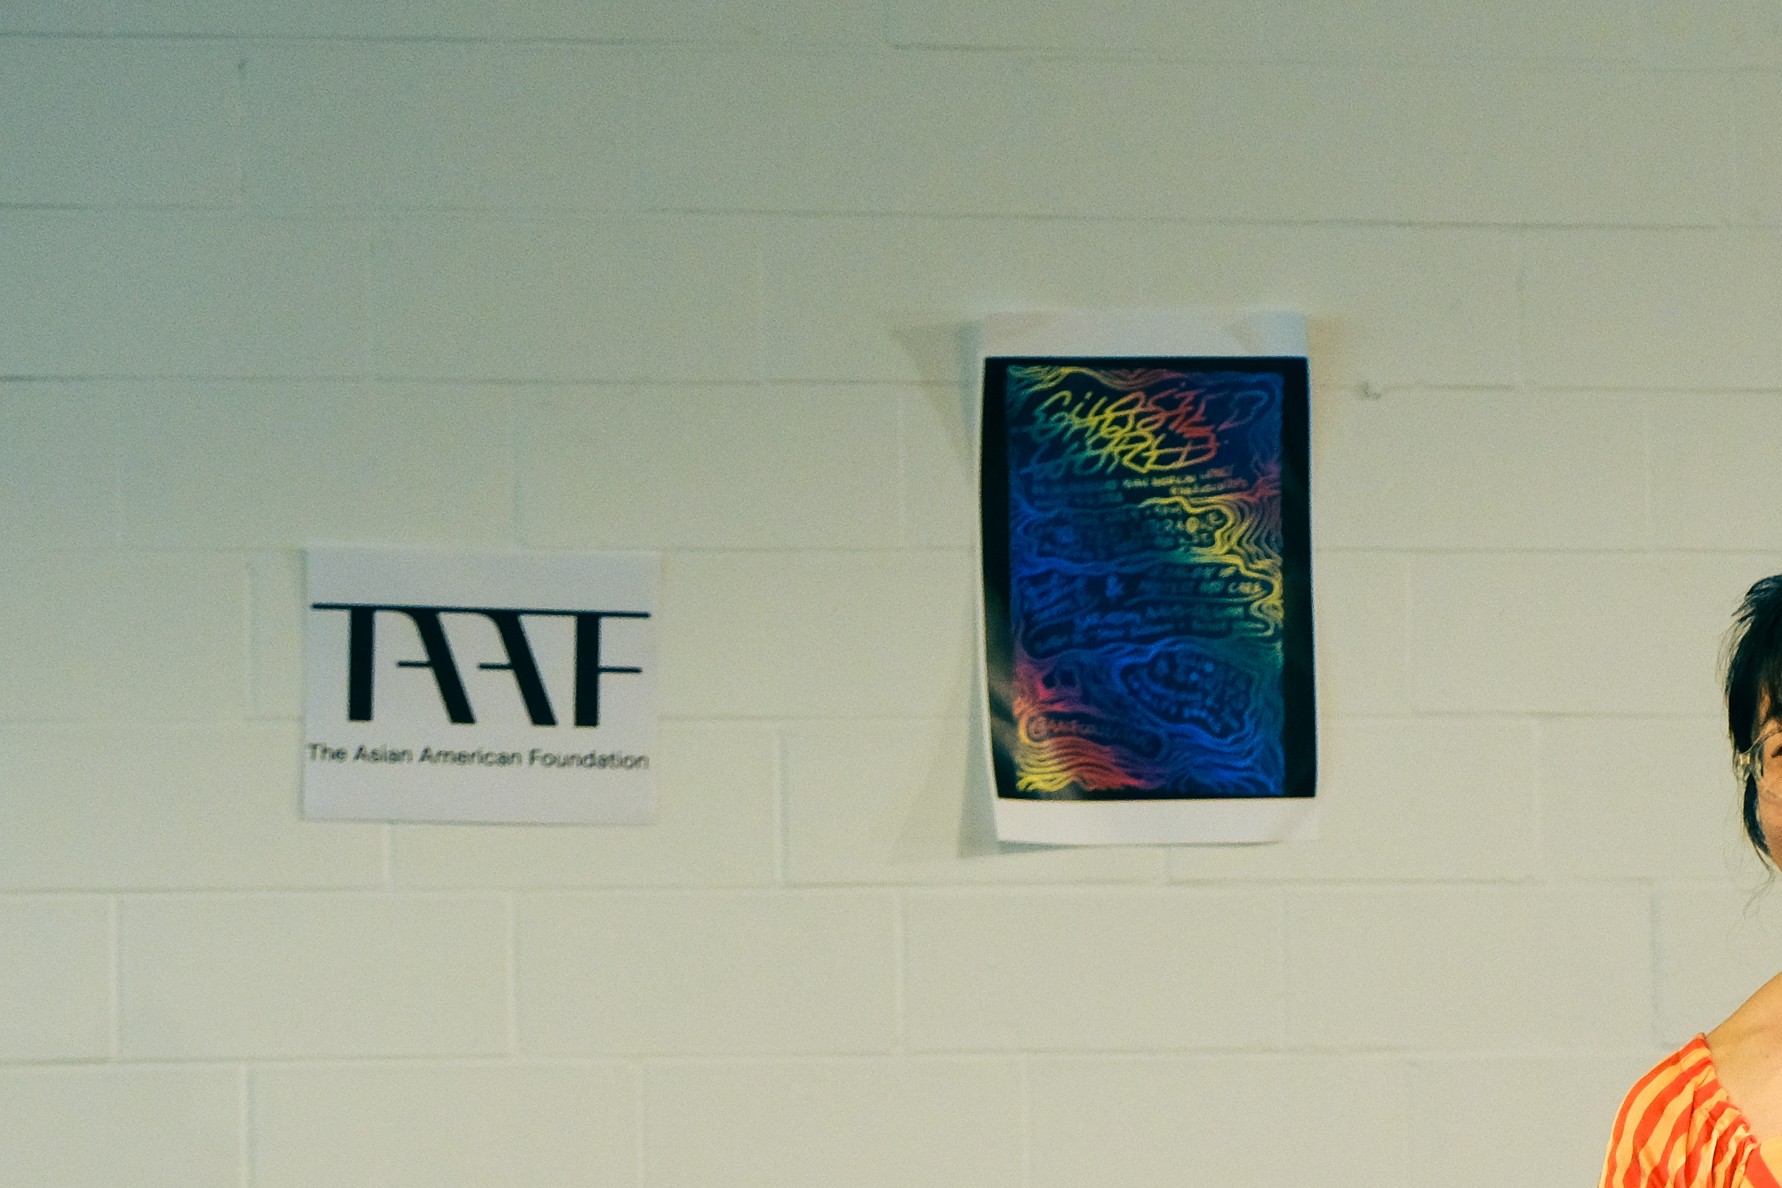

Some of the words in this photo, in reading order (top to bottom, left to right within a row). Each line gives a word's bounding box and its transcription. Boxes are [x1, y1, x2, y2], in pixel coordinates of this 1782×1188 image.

[310, 602, 652, 727] TAAF
[308, 743, 347, 764] The
[353, 745, 412, 765] Asian
[419, 746, 522, 768] American
[528, 748, 650, 770] Foundation
